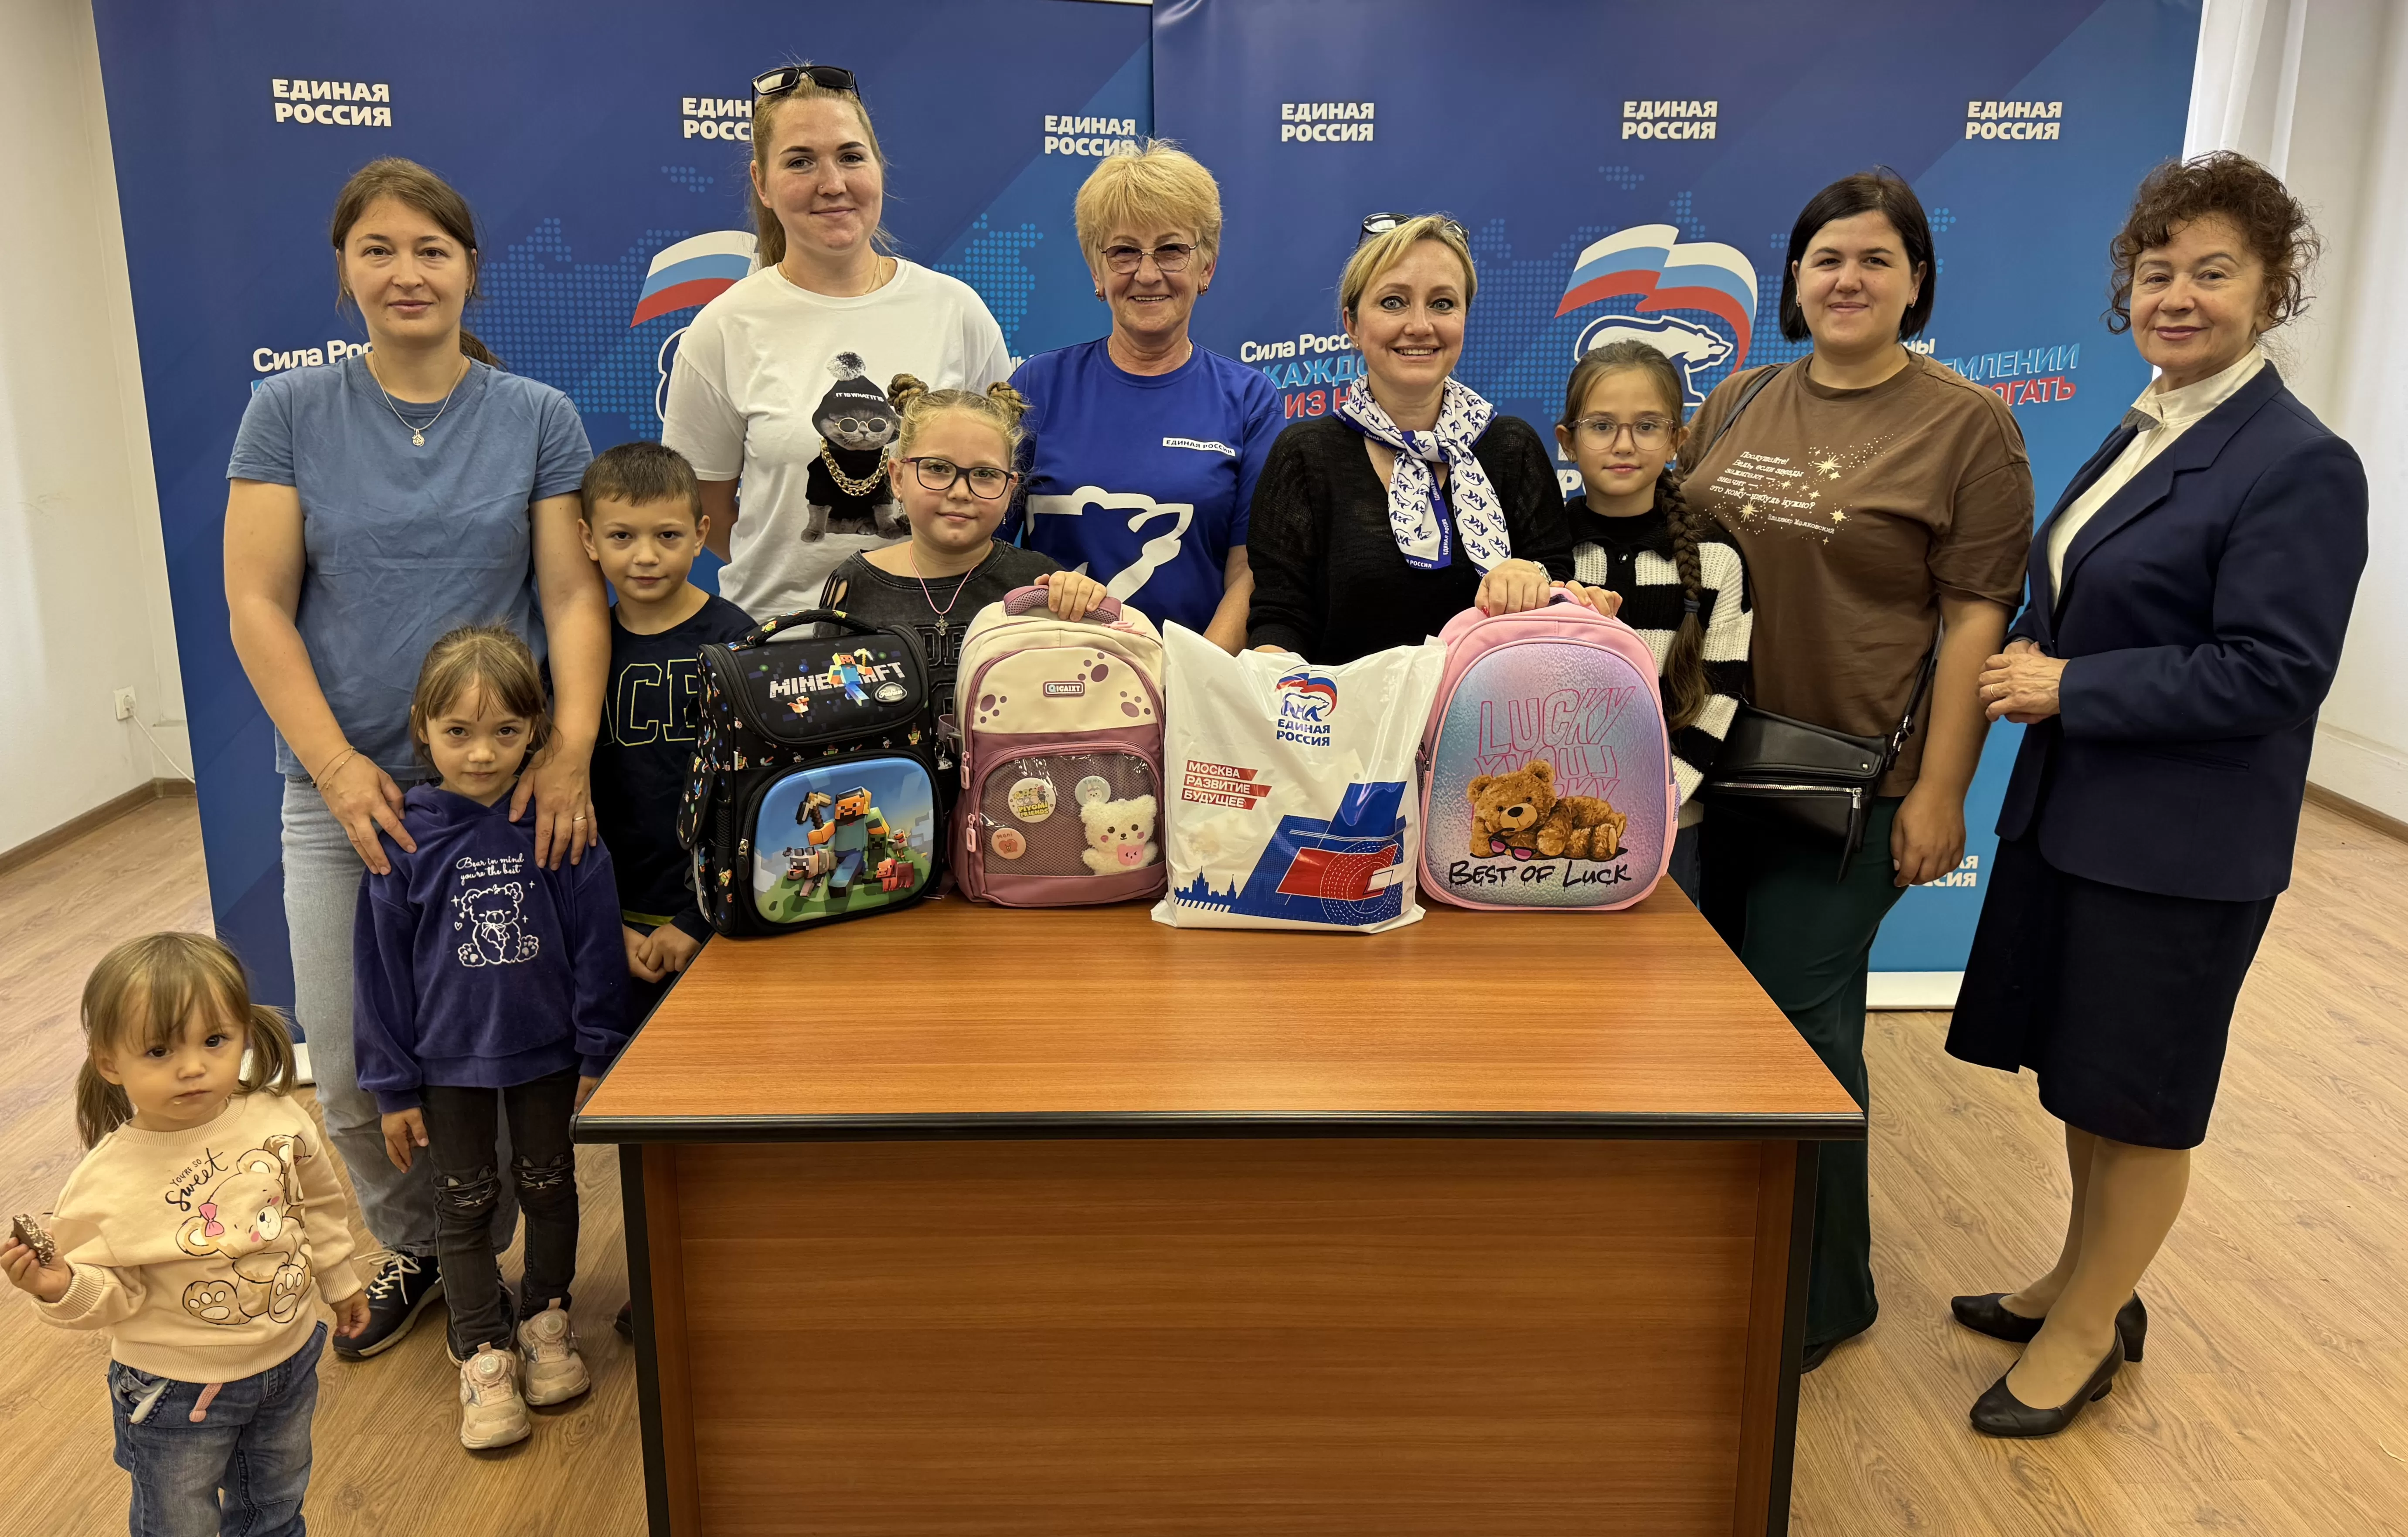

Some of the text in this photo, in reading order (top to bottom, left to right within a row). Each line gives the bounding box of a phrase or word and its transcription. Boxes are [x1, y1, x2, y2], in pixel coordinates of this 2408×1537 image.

[272, 79, 389, 102] ЕДИНАЯ
[275, 103, 391, 126] РОССИЯ
[682, 97, 751, 118] ЕДИН
[1282, 103, 1374, 122] ЕДИНАЯ
[1623, 101, 1718, 119] ЕДИНАЯ
[1968, 102, 2062, 119] ЕДИНАЯ
[683, 120, 753, 141] РОСС
[1045, 115, 1135, 136] ЕДИНАЯ
[1281, 123, 1374, 142] РОССИЯ
[1622, 122, 1716, 139] РОССИЯ
[1965, 122, 2060, 140] РОССИЯ
[1045, 136, 1134, 156] РОССИЯ
[1241, 334, 1352, 363] Сила Росс
[253, 348, 323, 372] Сила
[1263, 355, 1368, 390] КАЖДО
[1285, 390, 1326, 419] ИЗ
[1166, 440, 1232, 454] ЕДИНАЯ РОССИЯ
[1732, 459, 1754, 470] Ведь,
[1740, 451, 1790, 465] Послушайте!
[1717, 476, 1746, 486] значит
[1724, 468, 1765, 480] зажигают
[1724, 488, 1780, 504] кому-нибудь
[1781, 499, 1816, 509] нужно?
[1410, 560, 1432, 568] РОССИЯ
[1277, 719, 1330, 734] ЕДИНАЯ
[1479, 686, 1636, 757] LUCKY
[1276, 730, 1330, 746] РОССИЯ
[1188, 761, 1240, 778] МОСКВА
[1186, 775, 1250, 794] РАЗВИТИЕ
[1017, 801, 1048, 812] PIYOMI
[1184, 790, 1245, 808] БУДУЩЕЕ
[1020, 808, 1049, 818] FRIENDS
[456, 857, 486, 869] Bear
[500, 852, 524, 863] mind
[485, 865, 502, 875] the
[503, 863, 522, 874] best
[170, 1159, 202, 1186] YOU'RE SO
